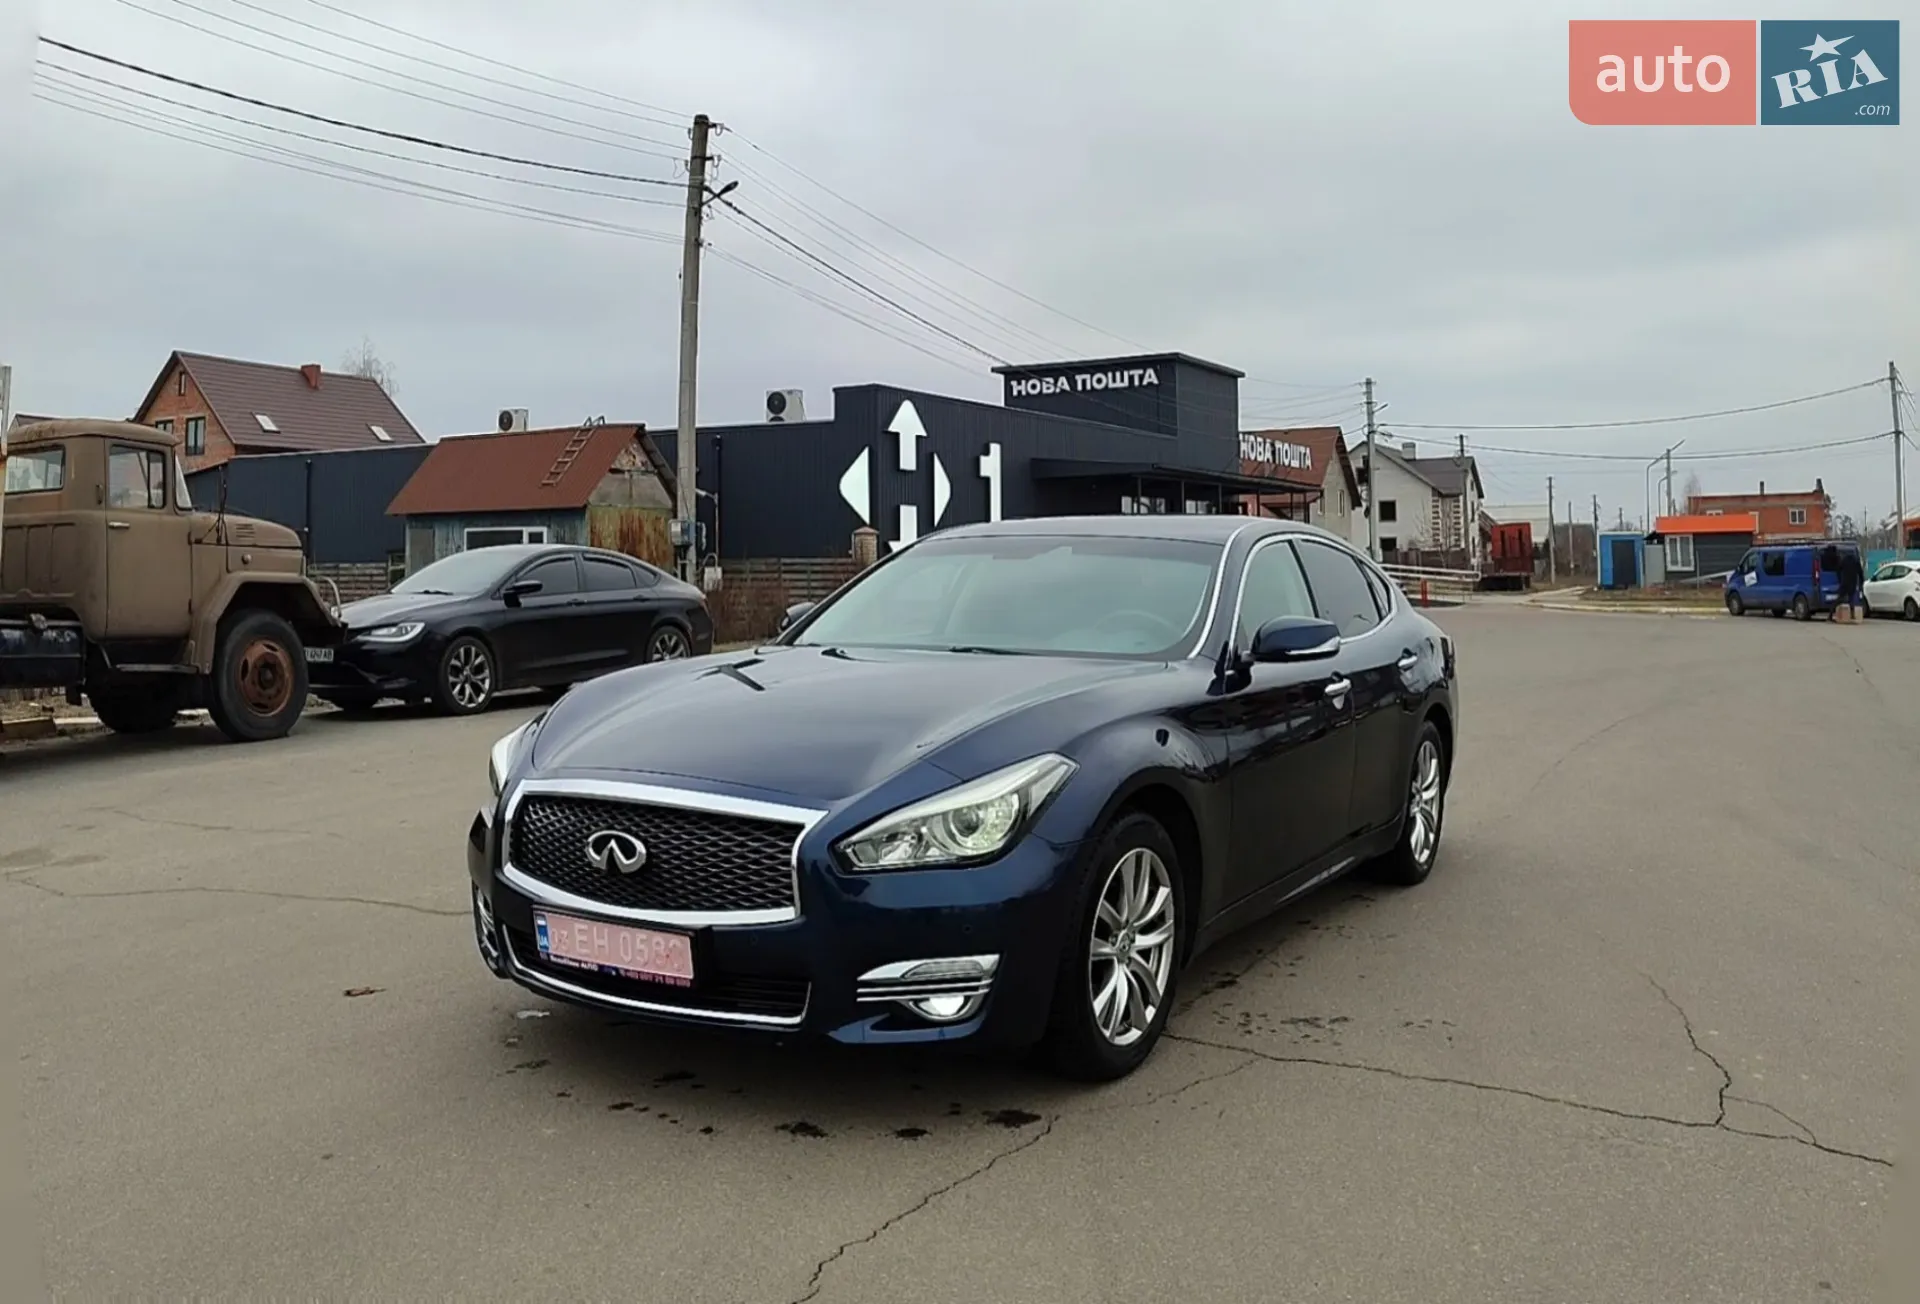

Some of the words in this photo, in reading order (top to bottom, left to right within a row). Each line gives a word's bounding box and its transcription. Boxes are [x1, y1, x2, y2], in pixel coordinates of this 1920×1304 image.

[1010, 376, 1071, 397] НОВА
[1075, 368, 1160, 392] ПОШТА
[1239, 433, 1273, 464] НОВА
[1274, 440, 1312, 471] ПОШТА
